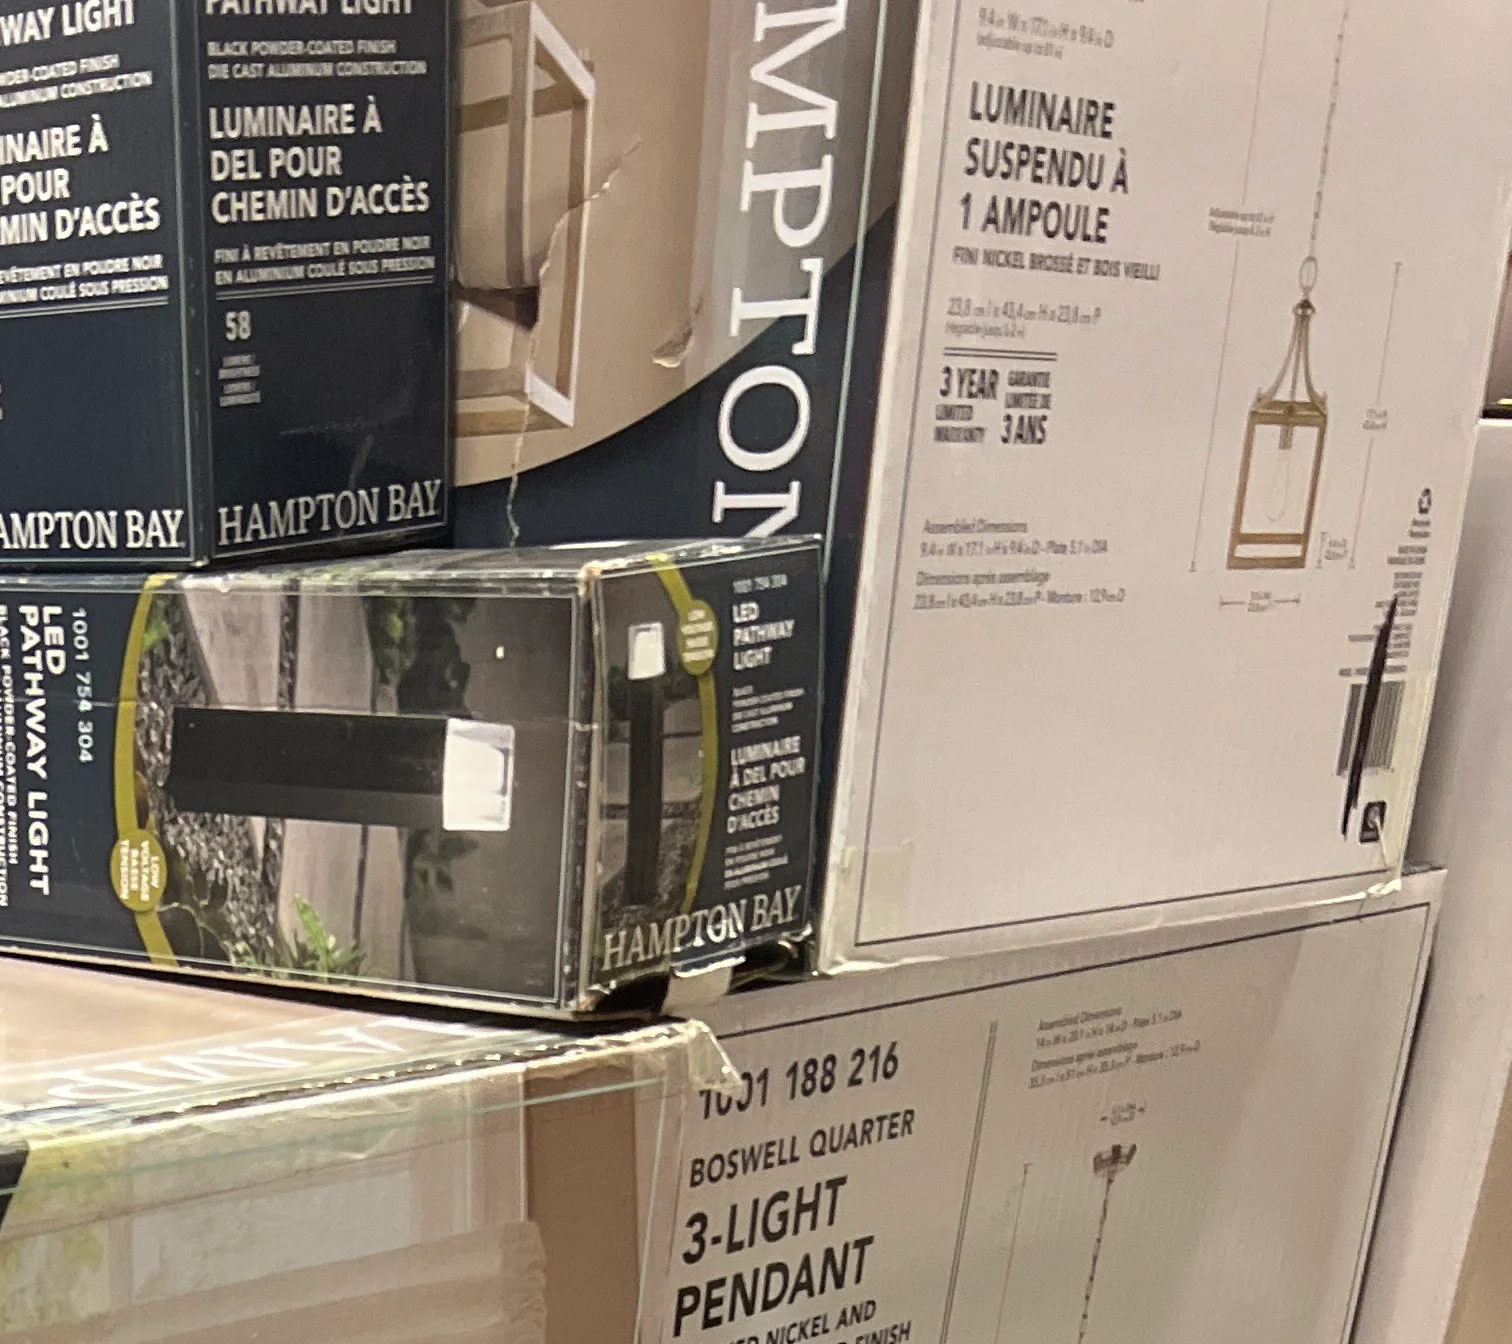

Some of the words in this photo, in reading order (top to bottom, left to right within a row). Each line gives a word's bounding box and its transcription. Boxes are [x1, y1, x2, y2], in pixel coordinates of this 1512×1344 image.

[63, 0, 136, 36] LIGHT
[969, 81, 1116, 139] LUMINAIRE
[89, 114, 108, 153] À
[1, 168, 70, 205] POUR
[964, 137, 1105, 192] SUSPENDU
[1110, 148, 1128, 194] À
[212, 190, 318, 224] CHEMIN
[960, 192, 972, 230] 1
[981, 194, 1110, 244] AMPOULE
[940, 366, 951, 397] 3
[957, 368, 1000, 401] YEAR
[1001, 413, 1013, 444] 3
[1015, 415, 1047, 445] ANS
[125, 509, 184, 549] BAY
[218, 486, 380, 546] HAMPTON
[387, 479, 441, 522] BAY
[733, 602, 759, 623] LED
[733, 620, 795, 647] PATHWAY
[43, 605, 66, 675] LED
[71, 608, 88, 661] 1001
[733, 647, 772, 670] LIGHT
[19, 604, 48, 779] PATHWAY
[75, 672, 93, 712] 754
[78, 721, 94, 763] 304
[731, 736, 801, 766] LUMINAIRE
[27, 792, 50, 895] LIGHT
[602, 899, 747, 970] HAMPTON
[750, 885, 802, 932] BAY
[786, 1056, 836, 1103] 188
[848, 1042, 900, 1091] 216
[689, 1133, 800, 1189] BOSWELL
[809, 1108, 915, 1160] QUARTER
[681, 1176, 849, 1266] 3-LIGHT
[671, 1236, 874, 1338] PENDANT
[836, 1299, 876, 1338] AND
